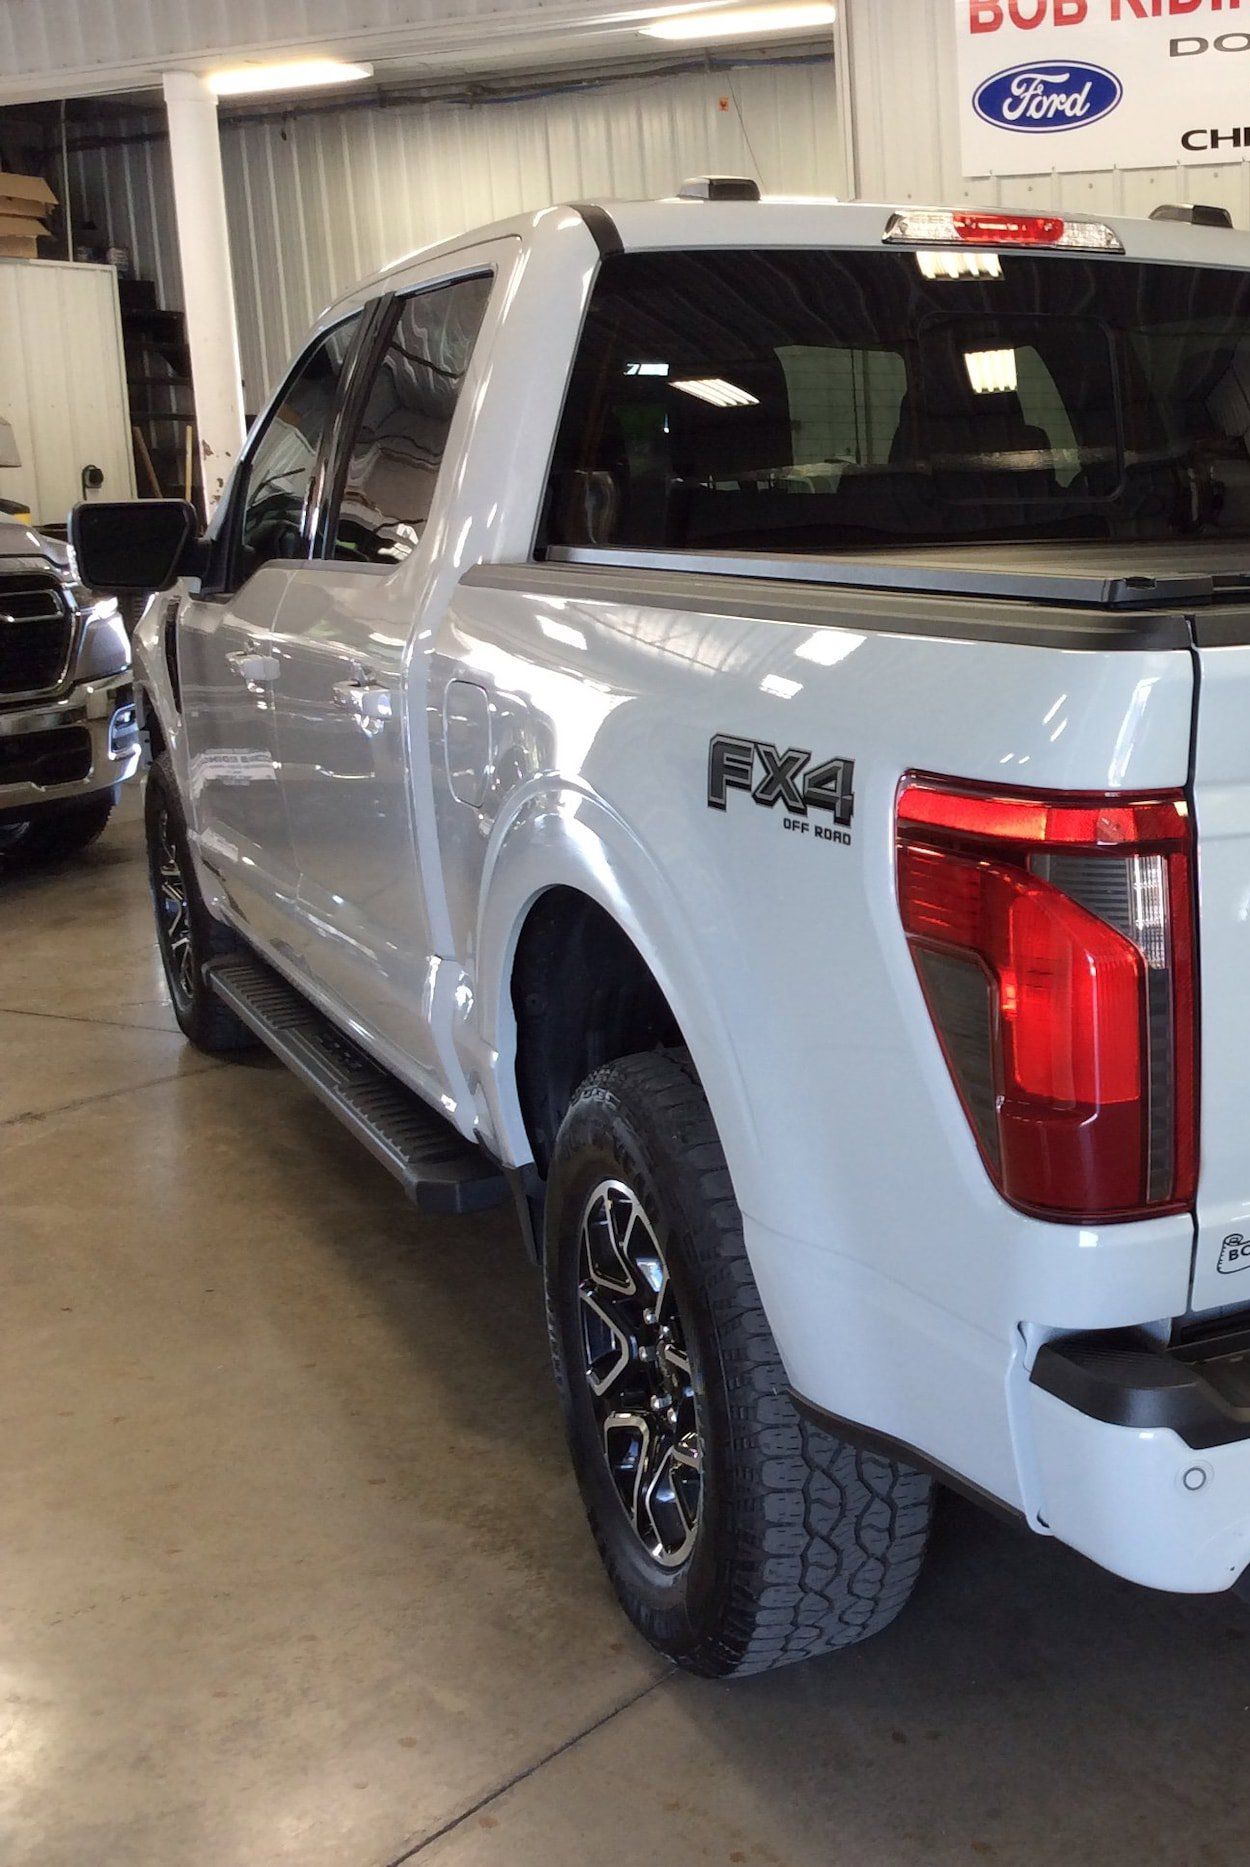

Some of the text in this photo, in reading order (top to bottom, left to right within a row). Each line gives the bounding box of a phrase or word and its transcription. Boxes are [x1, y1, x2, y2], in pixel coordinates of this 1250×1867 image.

[1002, 72, 1093, 121] Ford
[707, 733, 854, 828] FX4
[783, 817, 852, 846] OFF ROAD
